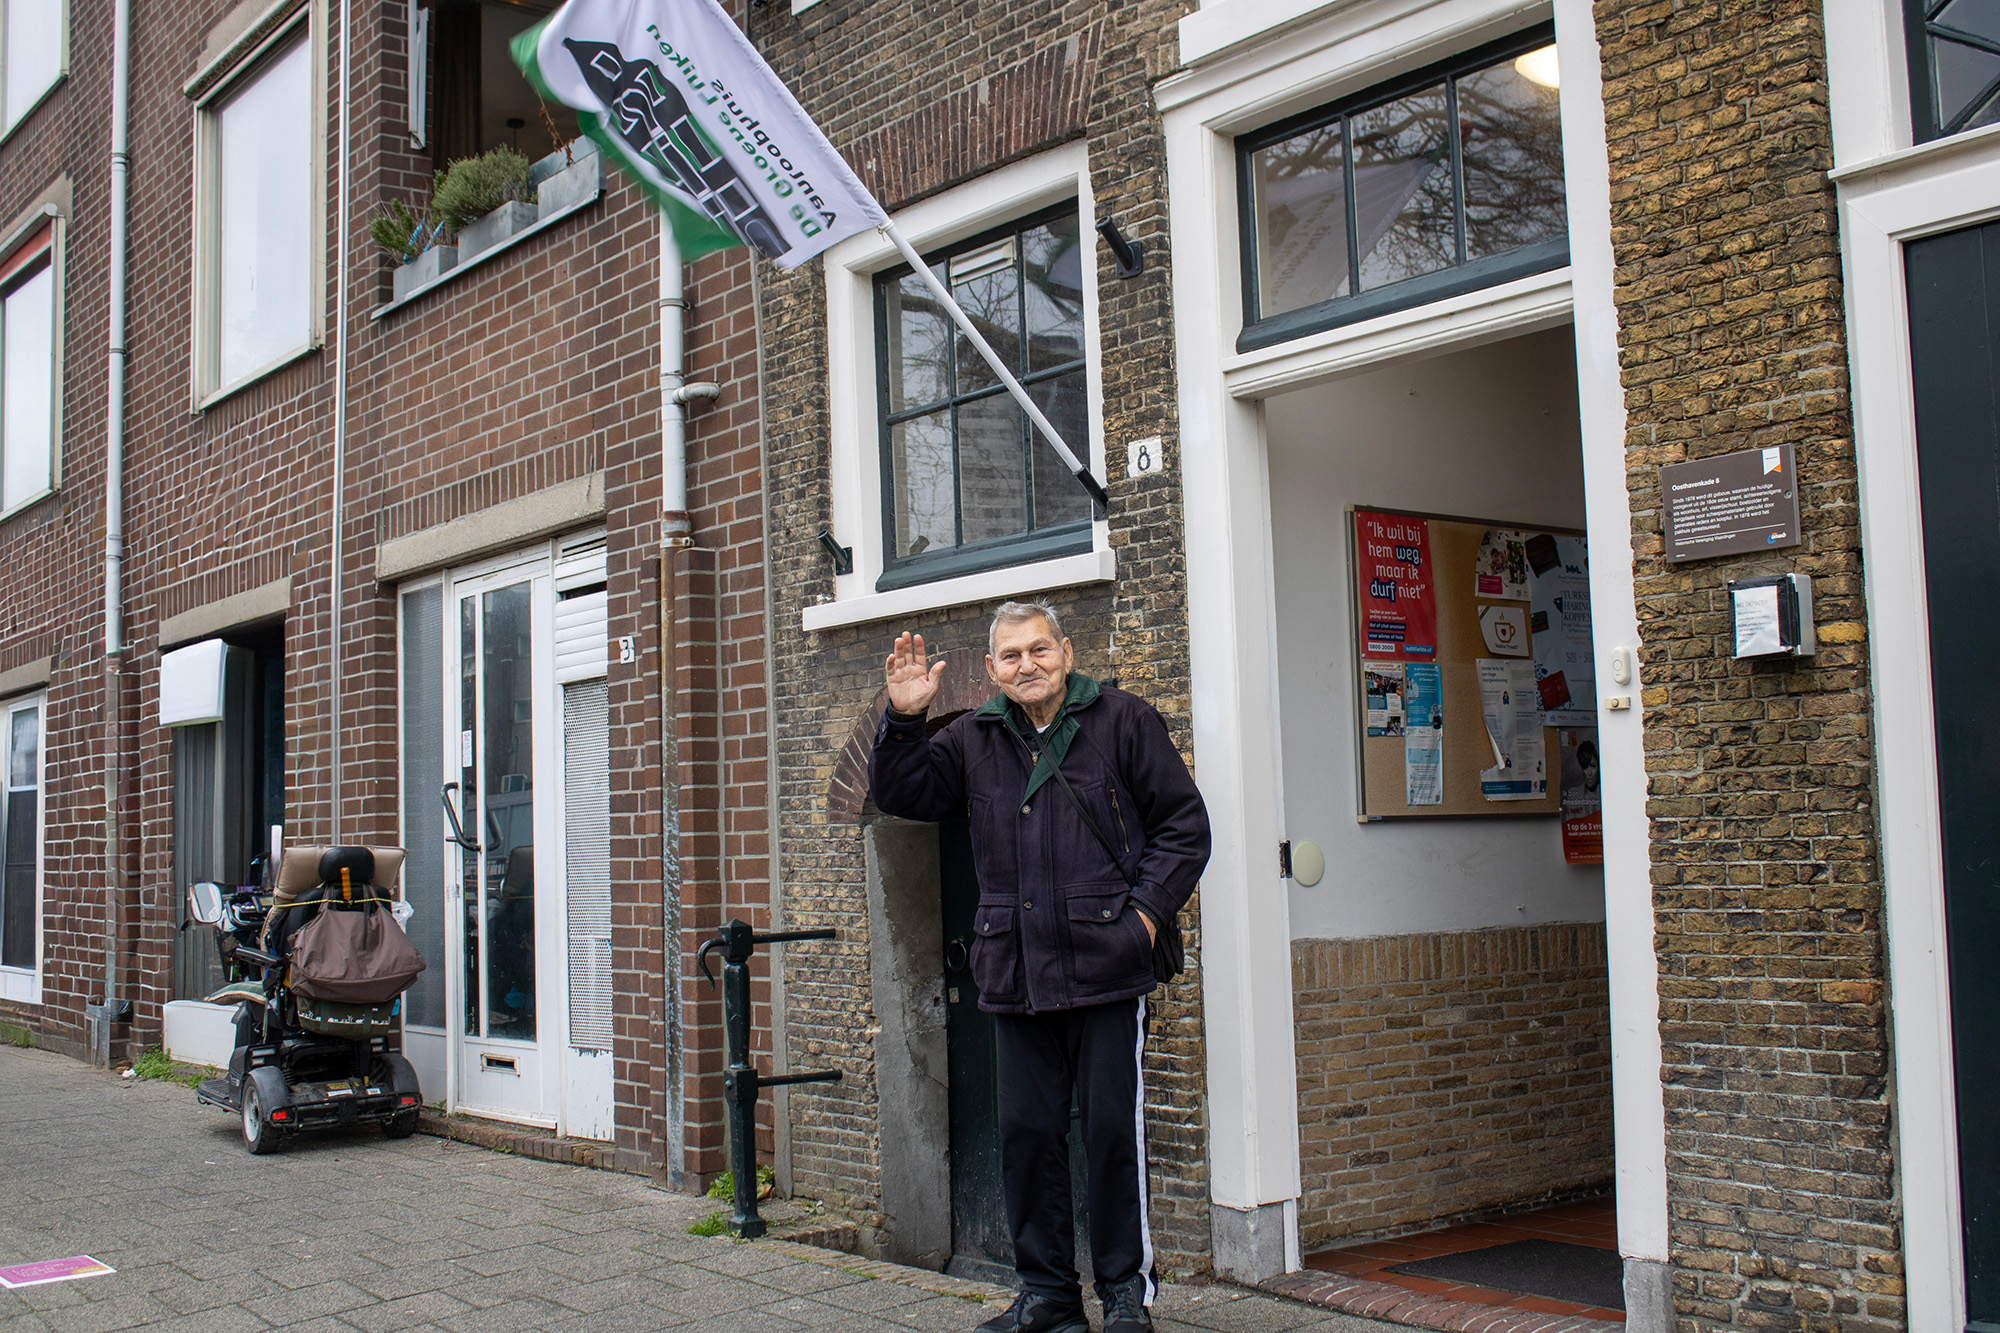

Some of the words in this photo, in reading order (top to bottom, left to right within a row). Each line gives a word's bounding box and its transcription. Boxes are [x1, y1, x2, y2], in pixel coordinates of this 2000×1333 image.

[1138, 445, 1150, 471] 8
[1672, 478, 1714, 491] Oosthavenkade
[1368, 522, 1384, 538] “Ik
[1387, 524, 1404, 540] wil
[1407, 526, 1420, 545] bij
[1368, 541, 1393, 558] hem
[1396, 548, 1422, 564] weg,
[1376, 565, 1405, 578] maar
[1408, 564, 1419, 580] ik
[1371, 580, 1395, 600] durf
[1398, 583, 1425, 599] niet”
[622, 640, 630, 660] 3
